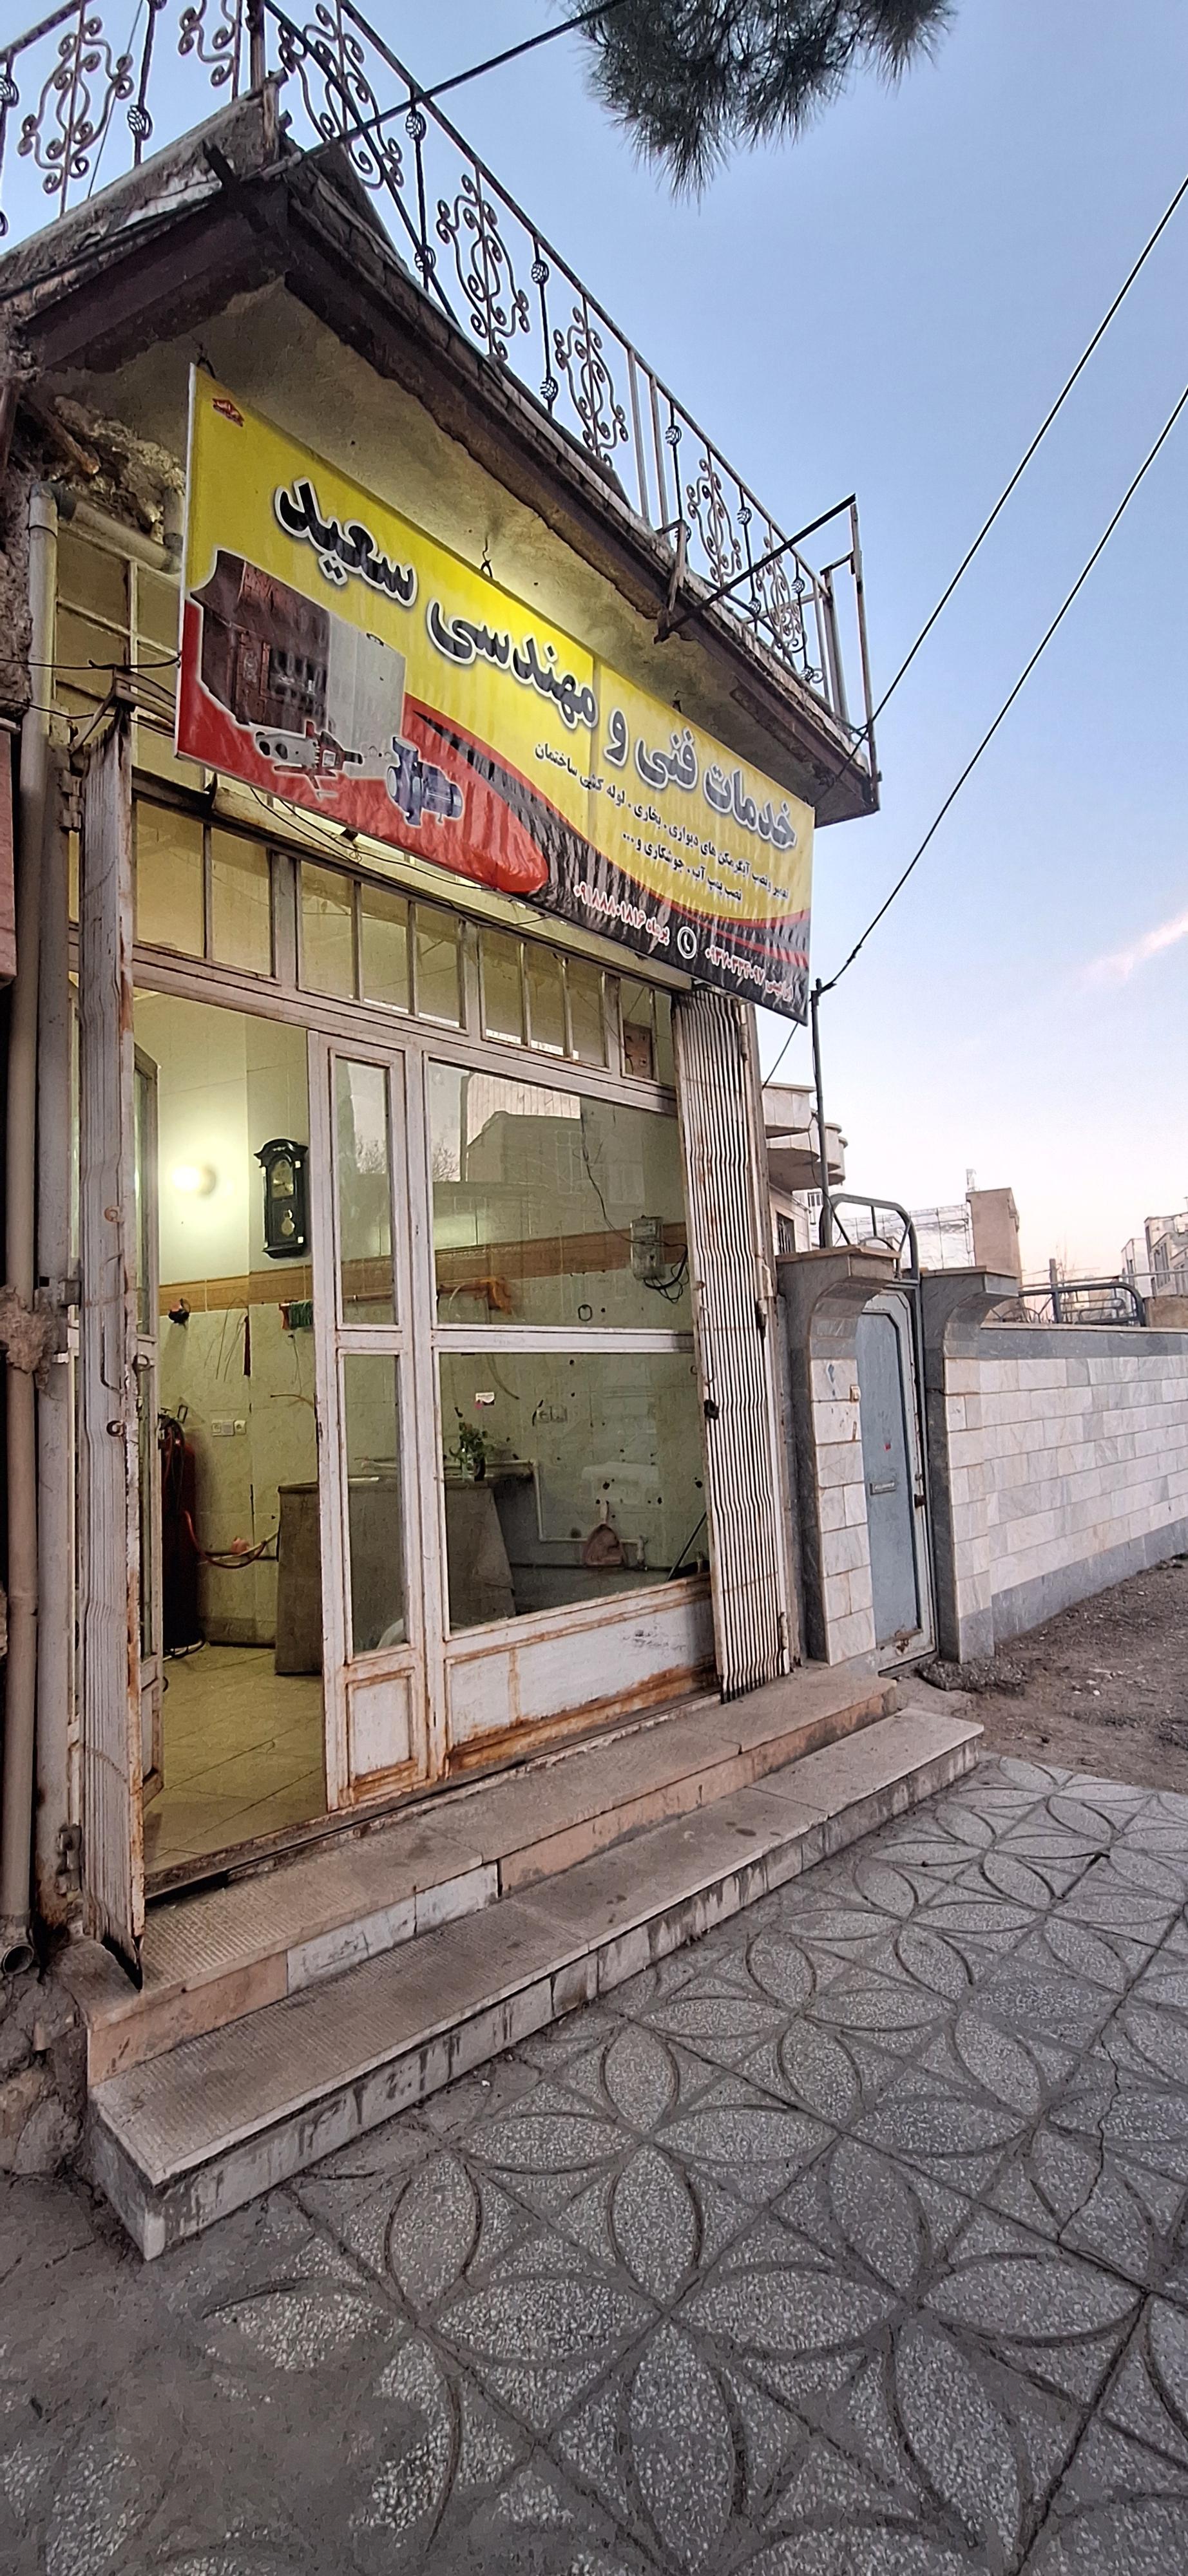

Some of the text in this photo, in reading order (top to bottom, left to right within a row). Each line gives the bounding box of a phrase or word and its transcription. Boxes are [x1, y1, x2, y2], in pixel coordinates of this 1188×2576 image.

[274, 477, 797, 849] خدمات فنی و مهندسی سعید
[535, 743, 577, 776] ساختمان
[580, 774, 604, 791] کشی
[606, 785, 626, 807] لوله
[634, 805, 662, 829] بخاری
[636, 838, 642, 852] و
[669, 825, 699, 848] دیواری
[644, 842, 685, 873] جوشکاری
[700, 841, 716, 857] های
[691, 866, 706, 881] آب
[752, 873, 769, 886] نصب
[707, 876, 723, 895] پمپ
[724, 886, 742, 901] نصب
